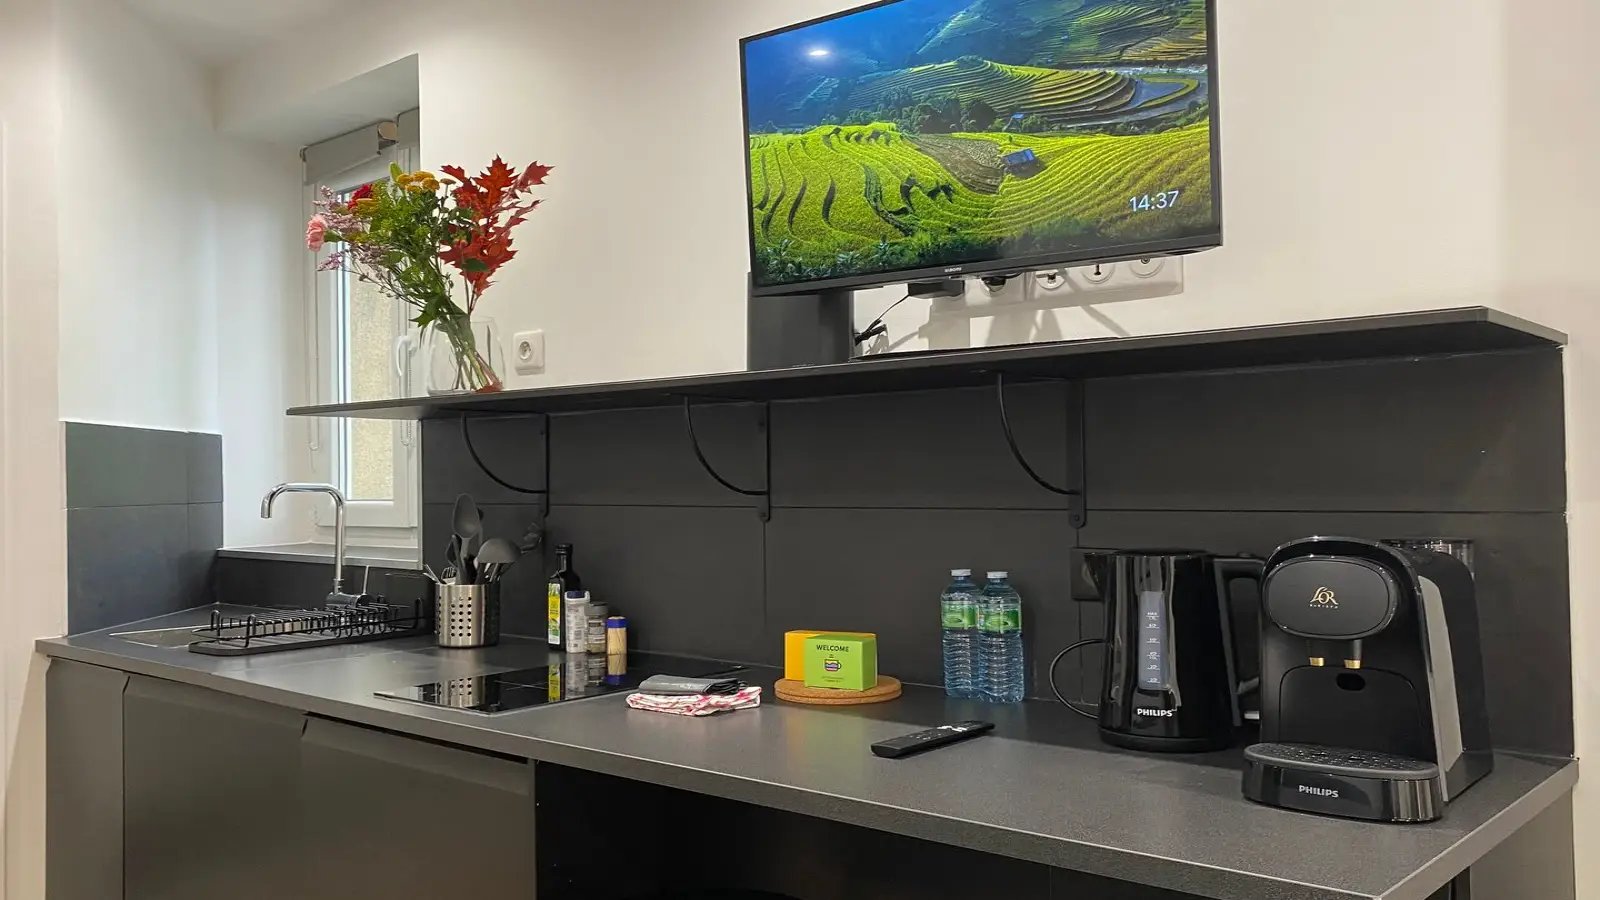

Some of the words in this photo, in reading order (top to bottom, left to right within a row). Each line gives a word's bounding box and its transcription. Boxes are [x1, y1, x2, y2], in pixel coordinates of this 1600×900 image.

[1129, 190, 1179, 212] 14:37
[816, 644, 849, 652] WELCOME
[1136, 708, 1173, 717] PHILIPS
[1298, 784, 1339, 798] PHILIPS
